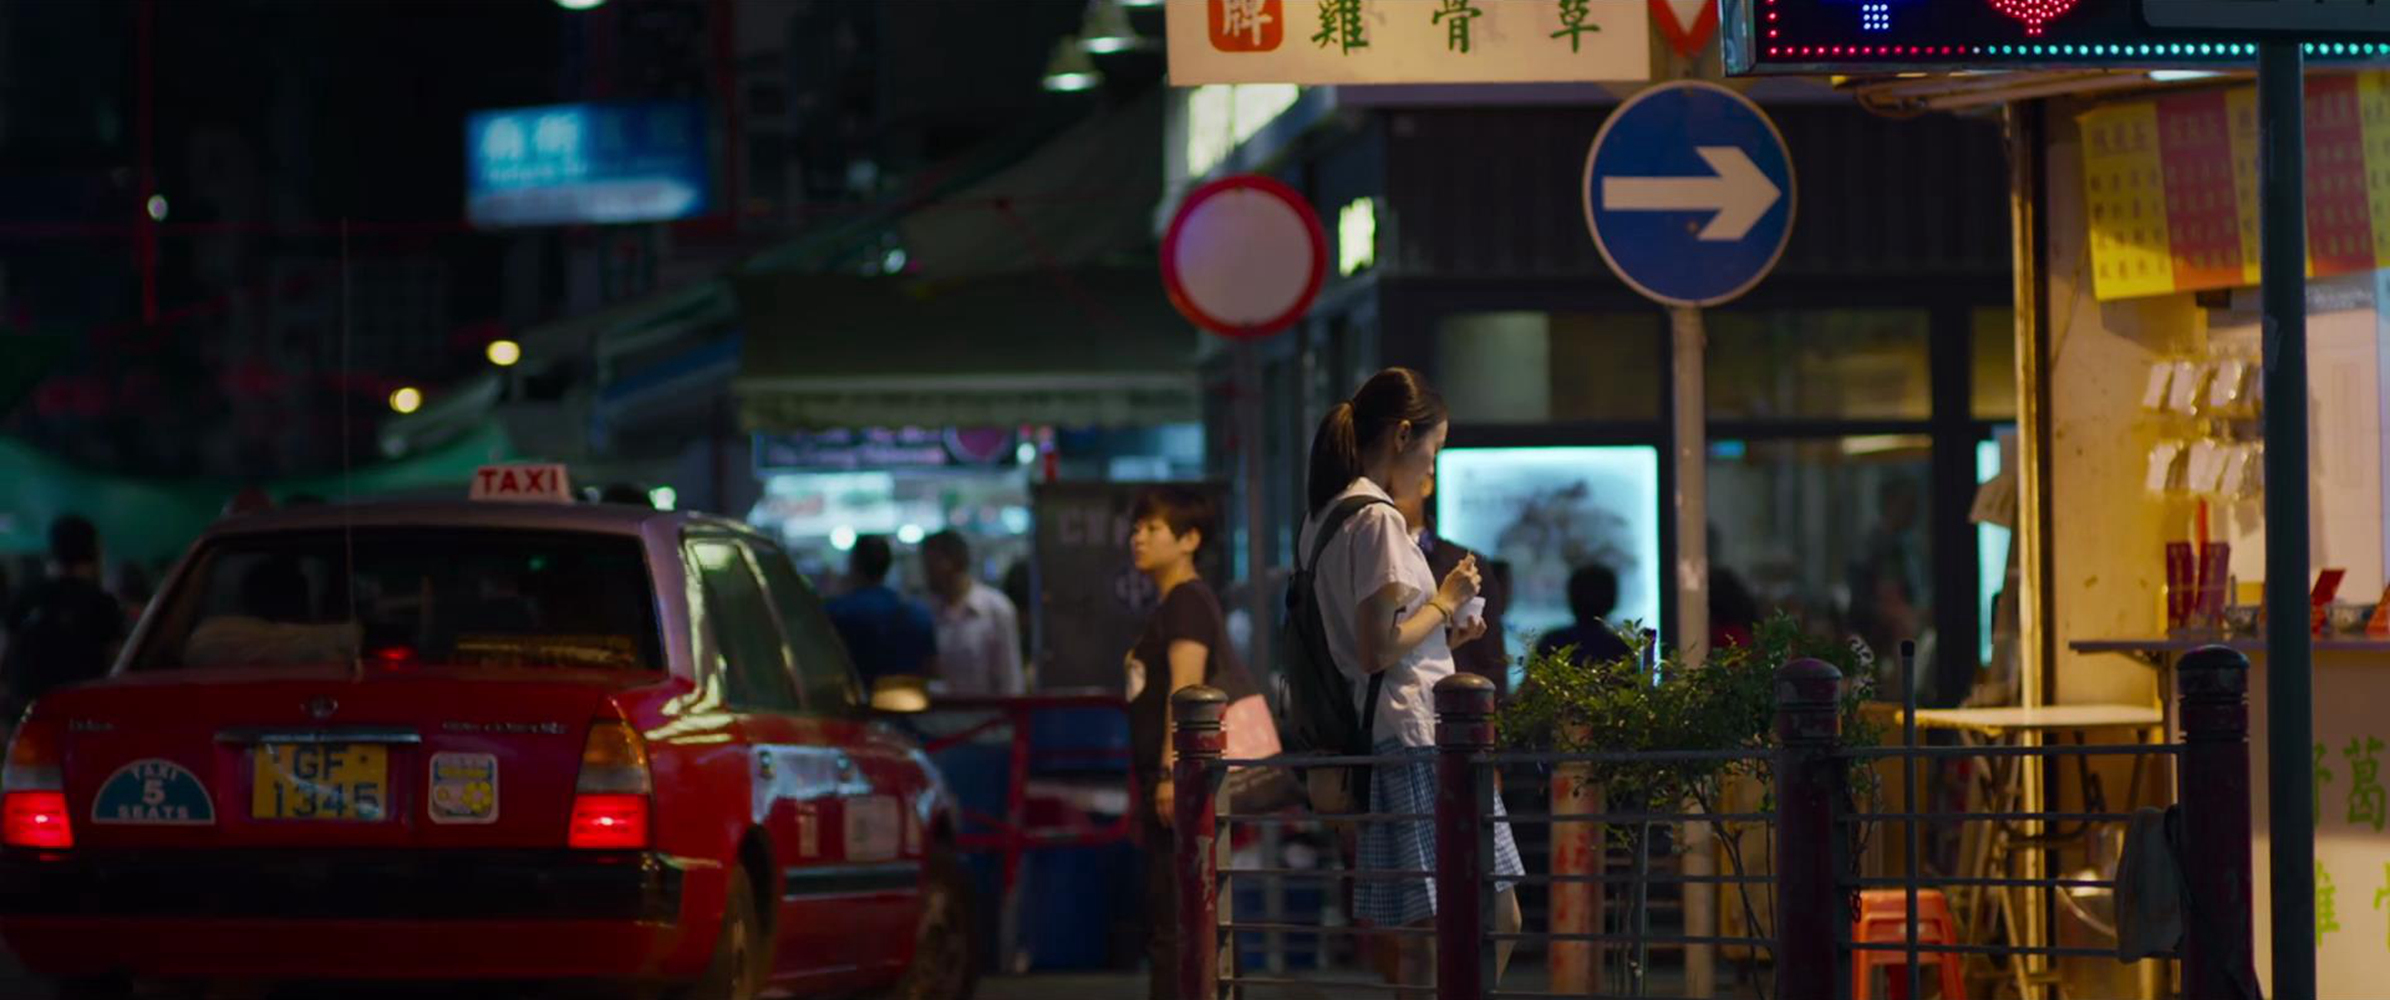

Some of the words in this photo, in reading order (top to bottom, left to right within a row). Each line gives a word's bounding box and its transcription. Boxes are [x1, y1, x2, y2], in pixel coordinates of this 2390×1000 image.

[477, 468, 557, 493] TAXI
[129, 763, 178, 782] TAXI
[293, 742, 348, 779] GF
[141, 779, 165, 805] 5
[273, 783, 380, 818] 1345
[117, 803, 189, 819] SEATS
